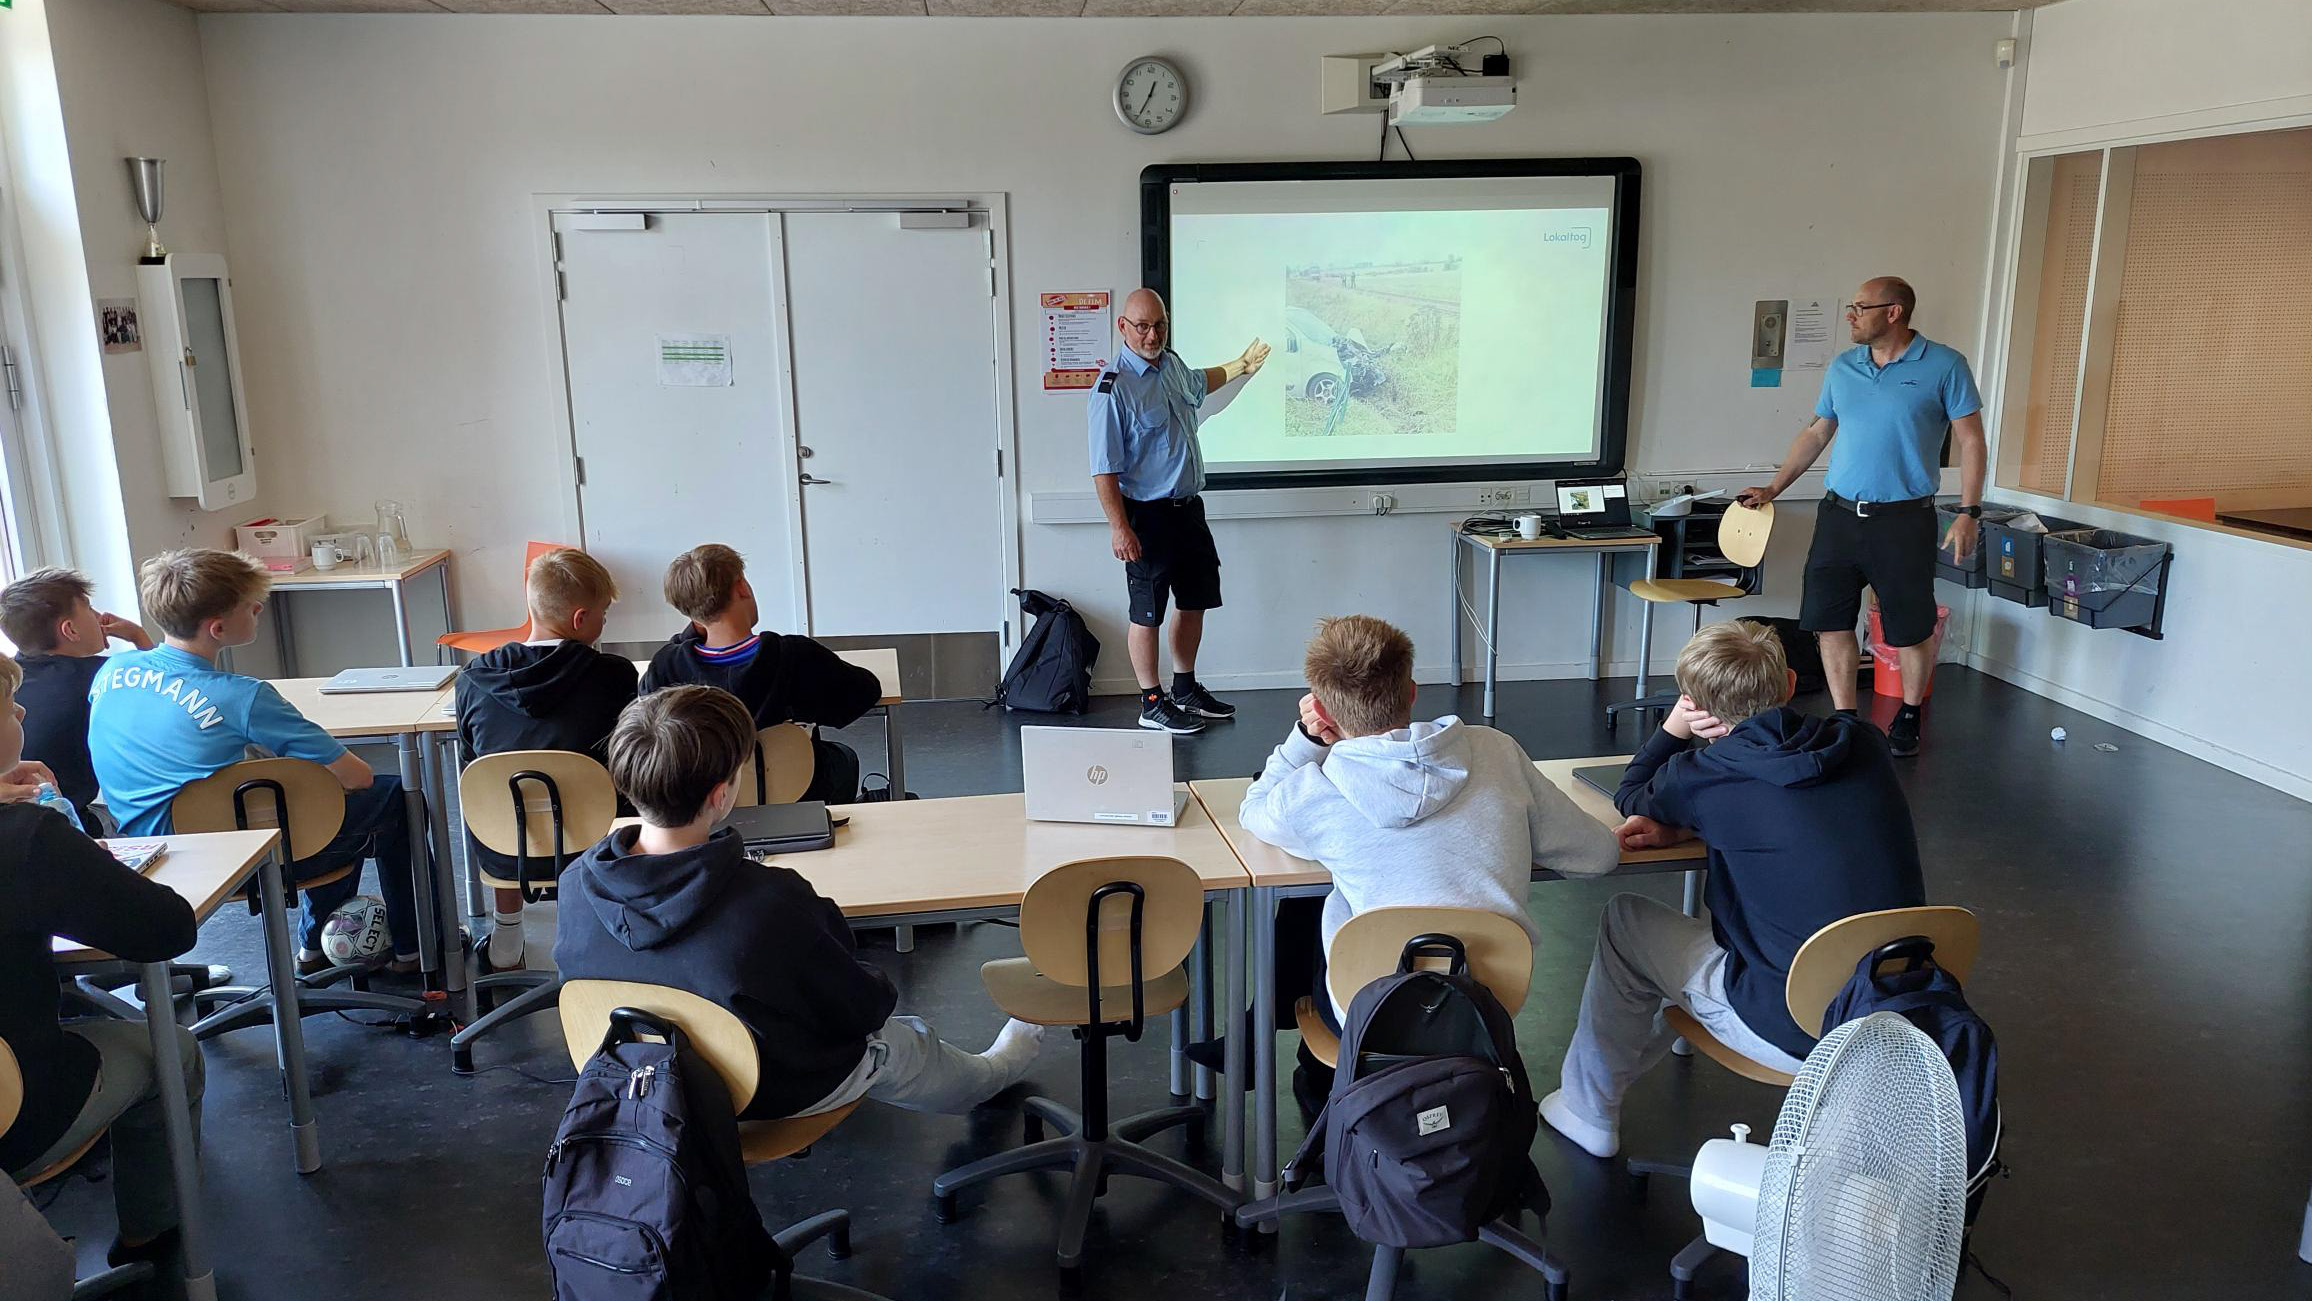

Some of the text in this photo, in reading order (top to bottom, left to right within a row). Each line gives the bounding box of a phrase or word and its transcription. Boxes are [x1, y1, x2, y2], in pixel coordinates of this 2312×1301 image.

[1544, 232, 1586, 244] Lokaltog
[90, 666, 224, 730] STEGMANN
[1088, 765, 1106, 785] hp
[362, 908, 386, 952] SELECT
